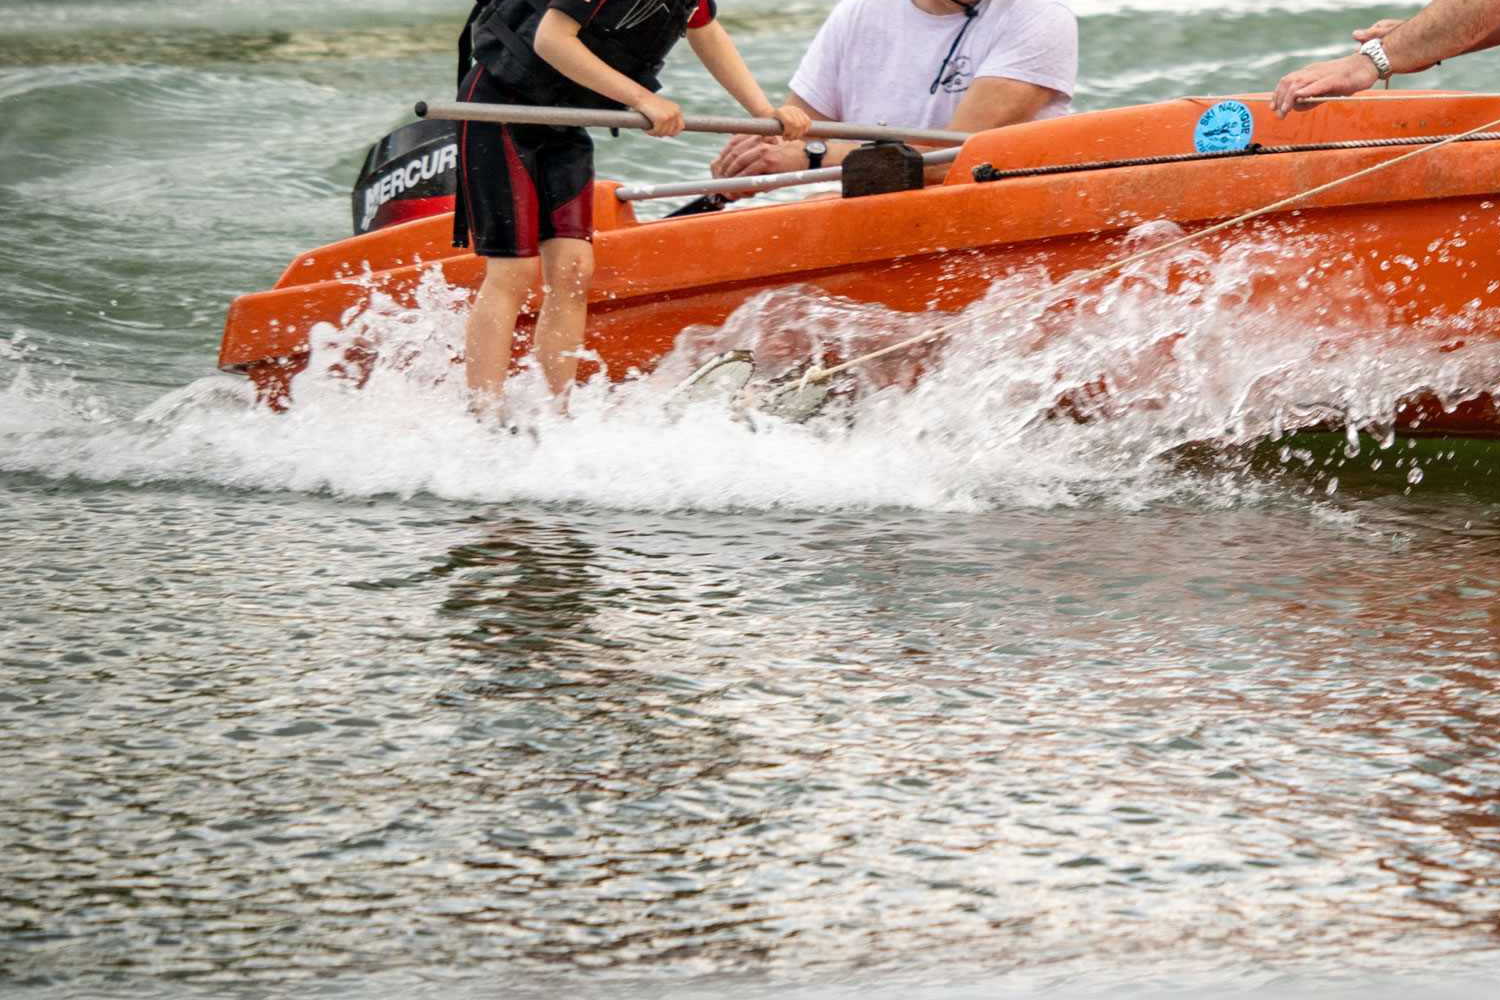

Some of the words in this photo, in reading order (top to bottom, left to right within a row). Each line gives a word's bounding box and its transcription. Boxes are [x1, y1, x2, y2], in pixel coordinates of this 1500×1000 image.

[1199, 108, 1216, 127] SKI
[1218, 102, 1252, 135] NAUTIQUE
[364, 142, 458, 207] MERCUR
